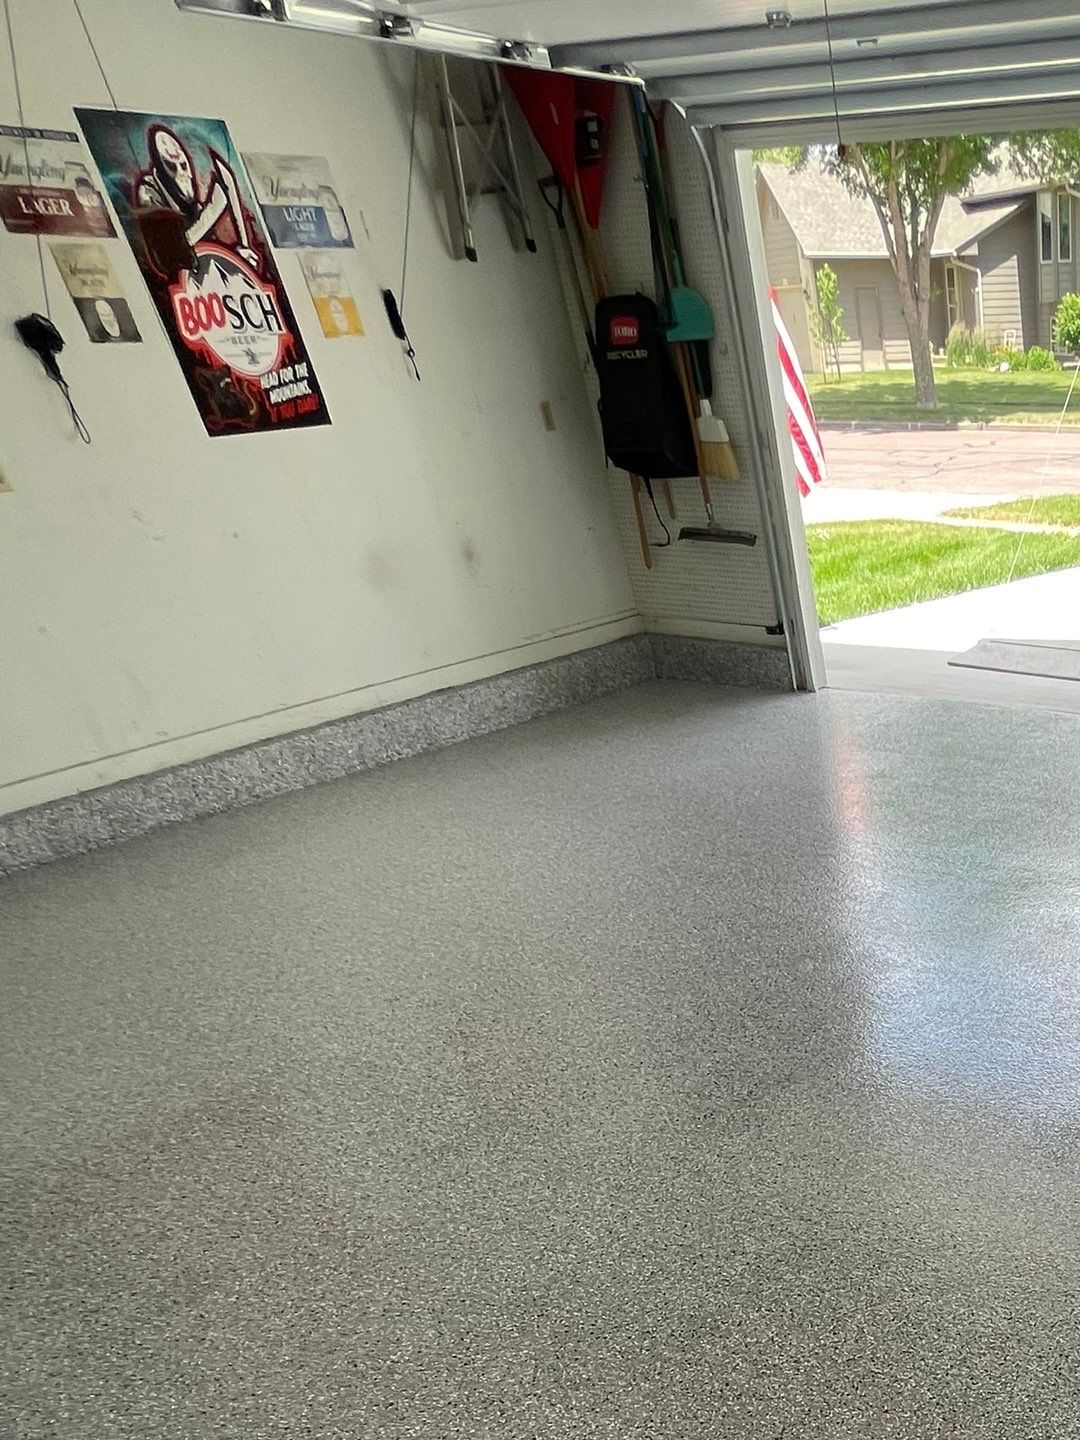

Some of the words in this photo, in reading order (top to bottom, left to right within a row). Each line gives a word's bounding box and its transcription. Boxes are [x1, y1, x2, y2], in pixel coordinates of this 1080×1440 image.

[17, 195, 76, 217] LAGER
[282, 207, 317, 222] LIGHT
[179, 292, 283, 335] BOOSCH
